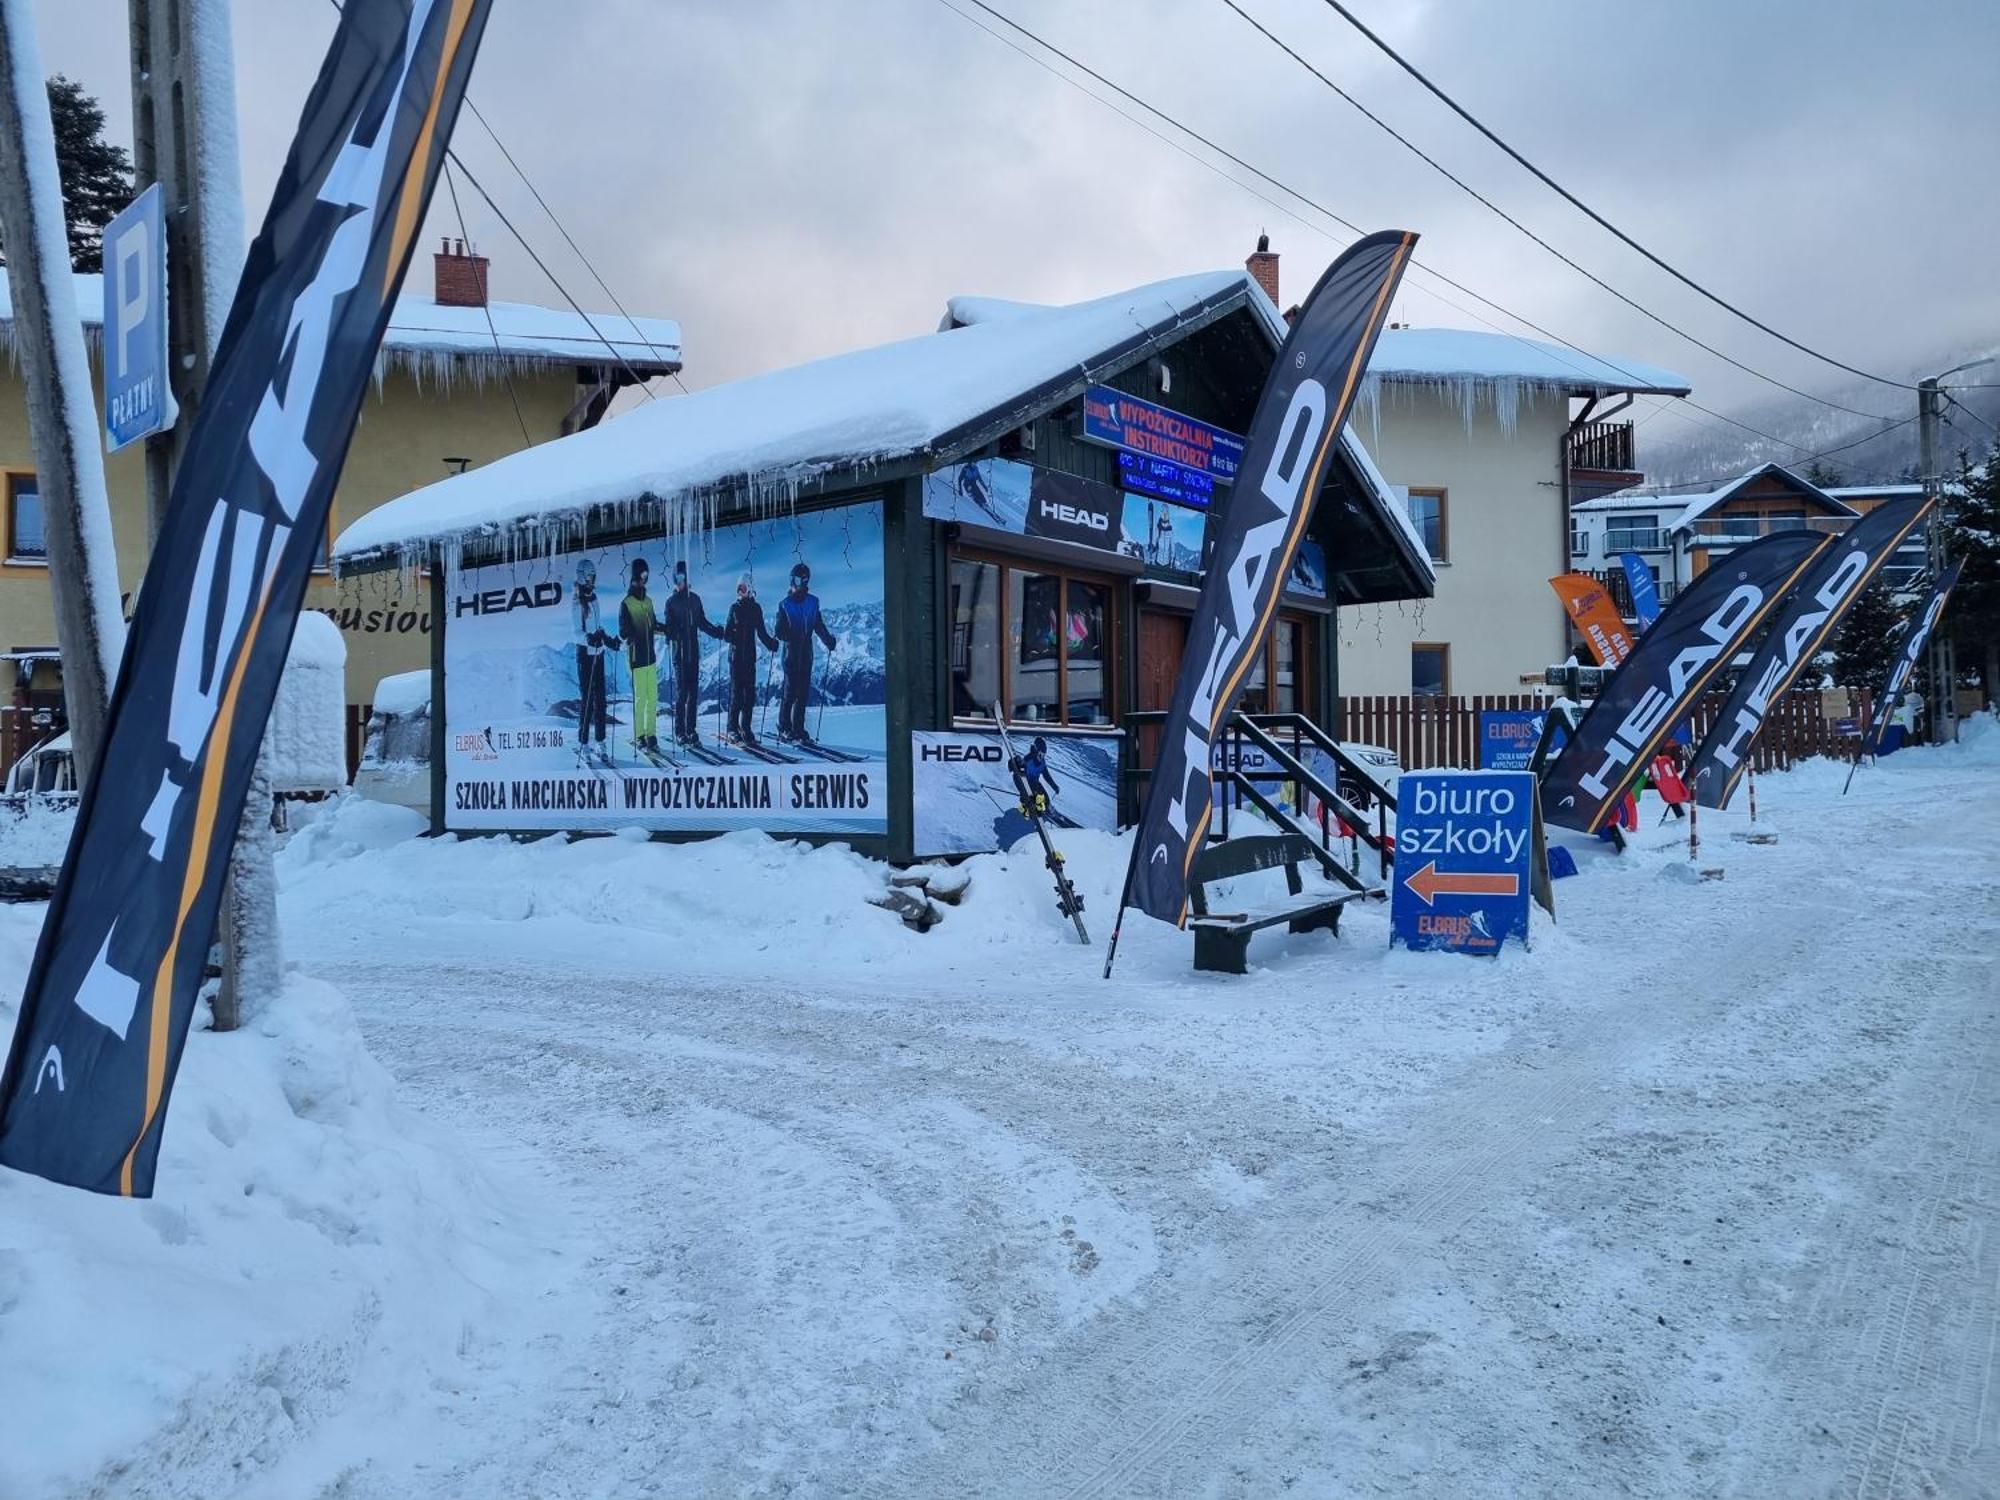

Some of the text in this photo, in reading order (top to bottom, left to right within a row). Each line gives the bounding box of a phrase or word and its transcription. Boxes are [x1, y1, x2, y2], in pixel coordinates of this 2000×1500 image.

[116, 220, 148, 378] P
[112, 375, 154, 429] PŁATNY
[1119, 400, 1213, 449] WYPOŻYCZALNIA
[1124, 426, 1210, 469] INSTRUKTORZY
[1041, 500, 1109, 531] HEAD
[456, 582, 562, 618] HEAD
[1167, 378, 1326, 842] HEAD
[1713, 551, 1868, 768] HEAD
[1578, 584, 1763, 800] HEAD
[498, 730, 564, 750] TEL. 512 166 186
[1489, 723, 1533, 739] ELBRUS
[921, 744, 1003, 762] HEAD
[456, 769, 869, 810] SZKOŁA NARCIARSKA WYPOŻYCZALNIA SERWIS
[1415, 782, 1515, 815] biuro
[1400, 820, 1527, 863] szkoły
[1418, 915, 1472, 936] ELBRUS
